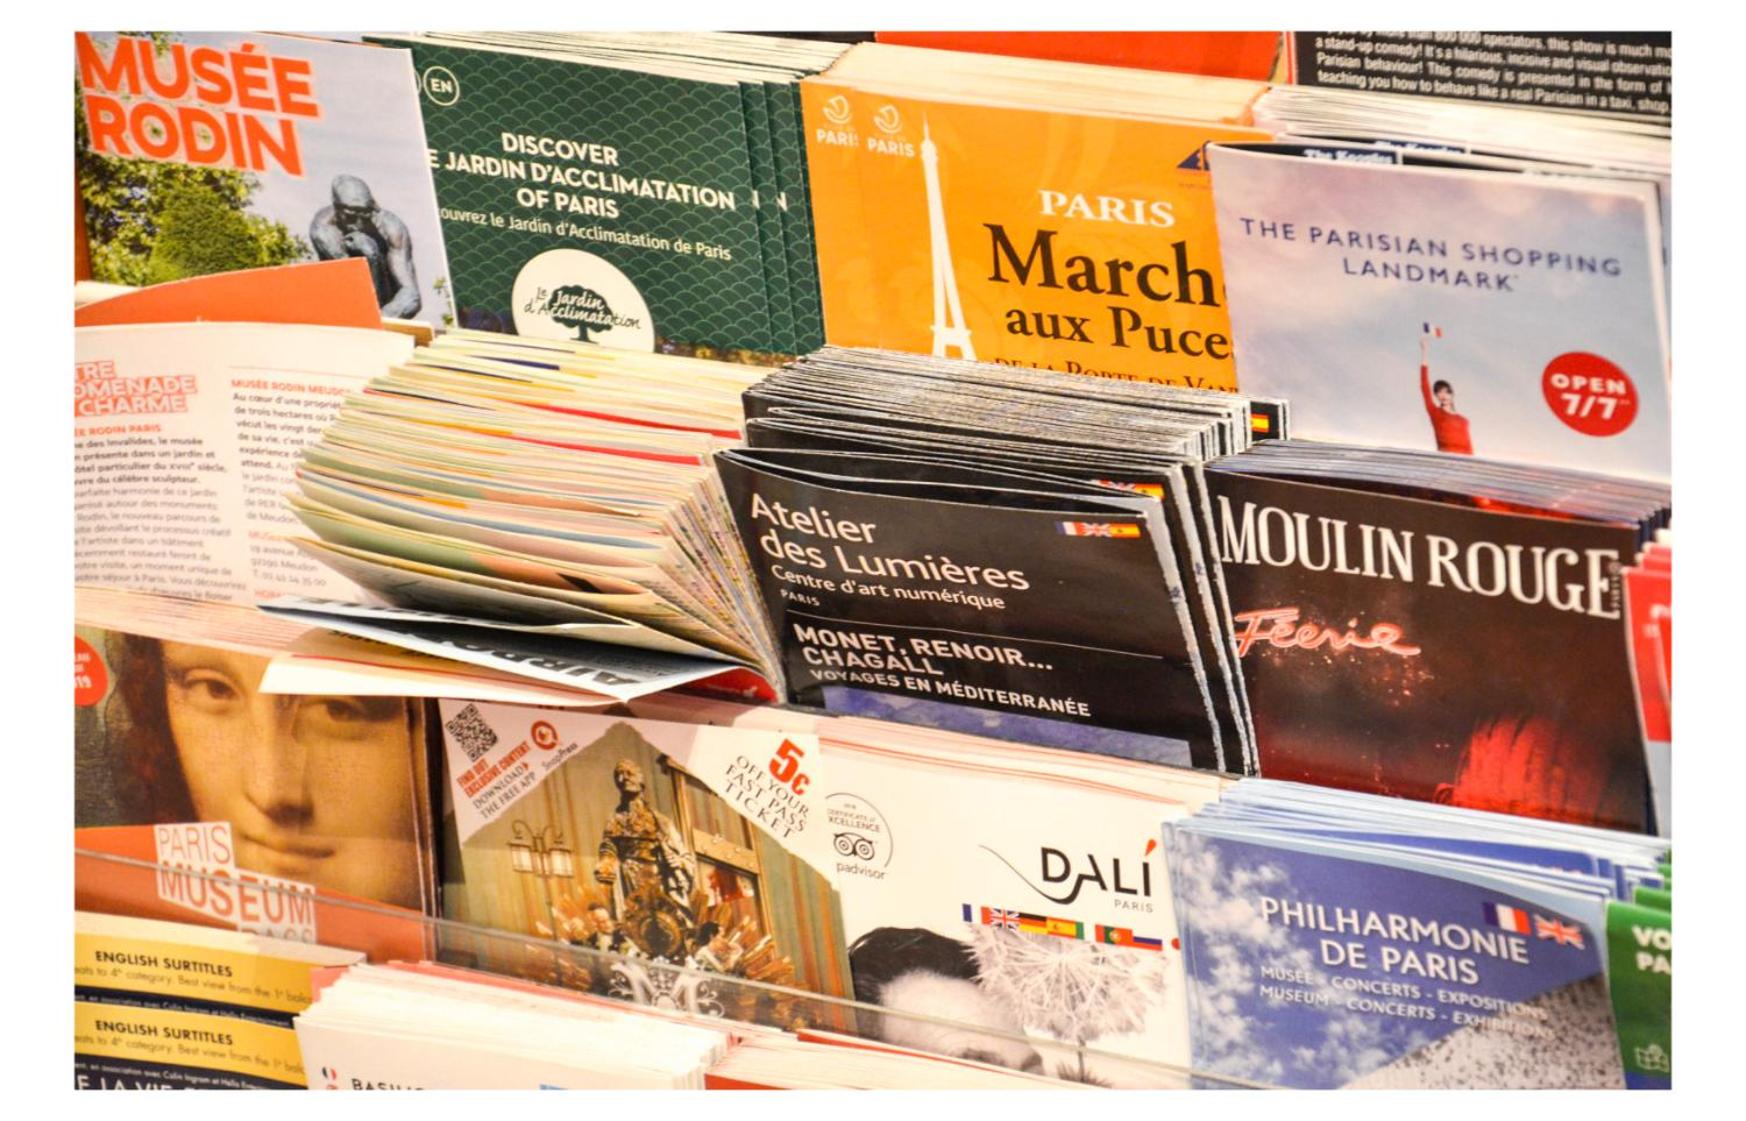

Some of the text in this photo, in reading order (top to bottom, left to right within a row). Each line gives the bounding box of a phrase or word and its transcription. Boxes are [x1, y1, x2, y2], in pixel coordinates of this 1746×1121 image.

[1375, 43, 1422, 58] comedy!
[1552, 57, 1573, 69] and
[1572, 40, 1603, 54] show
[1618, 44, 1652, 57] much
[75, 32, 322, 119] MUSÉE
[430, 77, 452, 93] EN
[1317, 52, 1361, 67] Parisian
[1428, 62, 1452, 76] This
[1455, 67, 1500, 84] comedy
[1593, 76, 1613, 89] the
[1318, 71, 1366, 89] teaching
[1368, 78, 1390, 89] you
[1392, 76, 1417, 90] how
[1419, 80, 1432, 92] to
[84, 94, 304, 176] RODIN
[501, 132, 619, 166] DISCOVER
[868, 136, 914, 158] PARIS
[445, 153, 735, 211] JARDIN D'ACCLIMATATION
[516, 188, 620, 219] OF PARIS
[1038, 189, 1176, 228] PARIS
[490, 211, 505, 227] le
[509, 215, 551, 233] Jardin
[555, 220, 670, 251] d'Acclimatation
[673, 238, 692, 253] de
[696, 241, 732, 261] Paris
[1240, 217, 1623, 277] THE PARISIAN SHOPPING
[982, 222, 1225, 308] March
[1343, 258, 1513, 292] LANDMARK
[536, 286, 547, 303] Le
[553, 291, 604, 310] Jardin
[1006, 306, 1233, 361] aux Puce
[271, 382, 305, 391] RODIN
[1550, 373, 1627, 396] OPEN
[79, 396, 187, 416] CHARME
[89, 424, 161, 435] RODIN PARIS
[751, 493, 877, 543] Atelier
[760, 530, 1031, 590] des Lumières
[1217, 494, 1621, 619] MOULIN ROUGE
[771, 565, 1006, 611] Centre d'art numérique
[780, 589, 821, 607] PARIS
[793, 623, 1053, 671] MONET, RENOIR...
[1235, 607, 1421, 657] Féerie
[803, 649, 945, 676] CHAGALL
[810, 668, 1091, 717] VOYAGES EN MÉDITERRANÉE
[456, 758, 488, 786] FIND OUT
[464, 741, 530, 798] EXCLUSIVE CONTENT
[473, 765, 524, 808] DOWNLOAD
[736, 755, 810, 818] OFF YOUR
[480, 772, 536, 818] THE FREE APP
[726, 764, 805, 832] FAST PASS
[726, 780, 795, 838] TICKET
[158, 825, 231, 864] PARIS
[837, 862, 887, 880] padvisor
[1041, 839, 1161, 903] DALÍ
[162, 861, 313, 925] MUSEUM
[1114, 899, 1153, 914] PARIS
[1261, 897, 1530, 964] PHILHARMONIE
[1632, 924, 1672, 950] VO
[95, 950, 233, 977] ENGLISH SURTITLES
[179, 976, 199, 986] Best
[1320, 939, 1480, 985] DE PARIS
[1636, 952, 1672, 975] PA
[1260, 985, 1553, 1038] MUSEUM CONCERTS EXHIBITIONS
[1332, 976, 1421, 998] CONCERTS
[1438, 989, 1548, 1020] EXPOSITIONS
[95, 1020, 234, 1045] ENGLISH SURTITLES
[179, 1044, 199, 1054] Best
